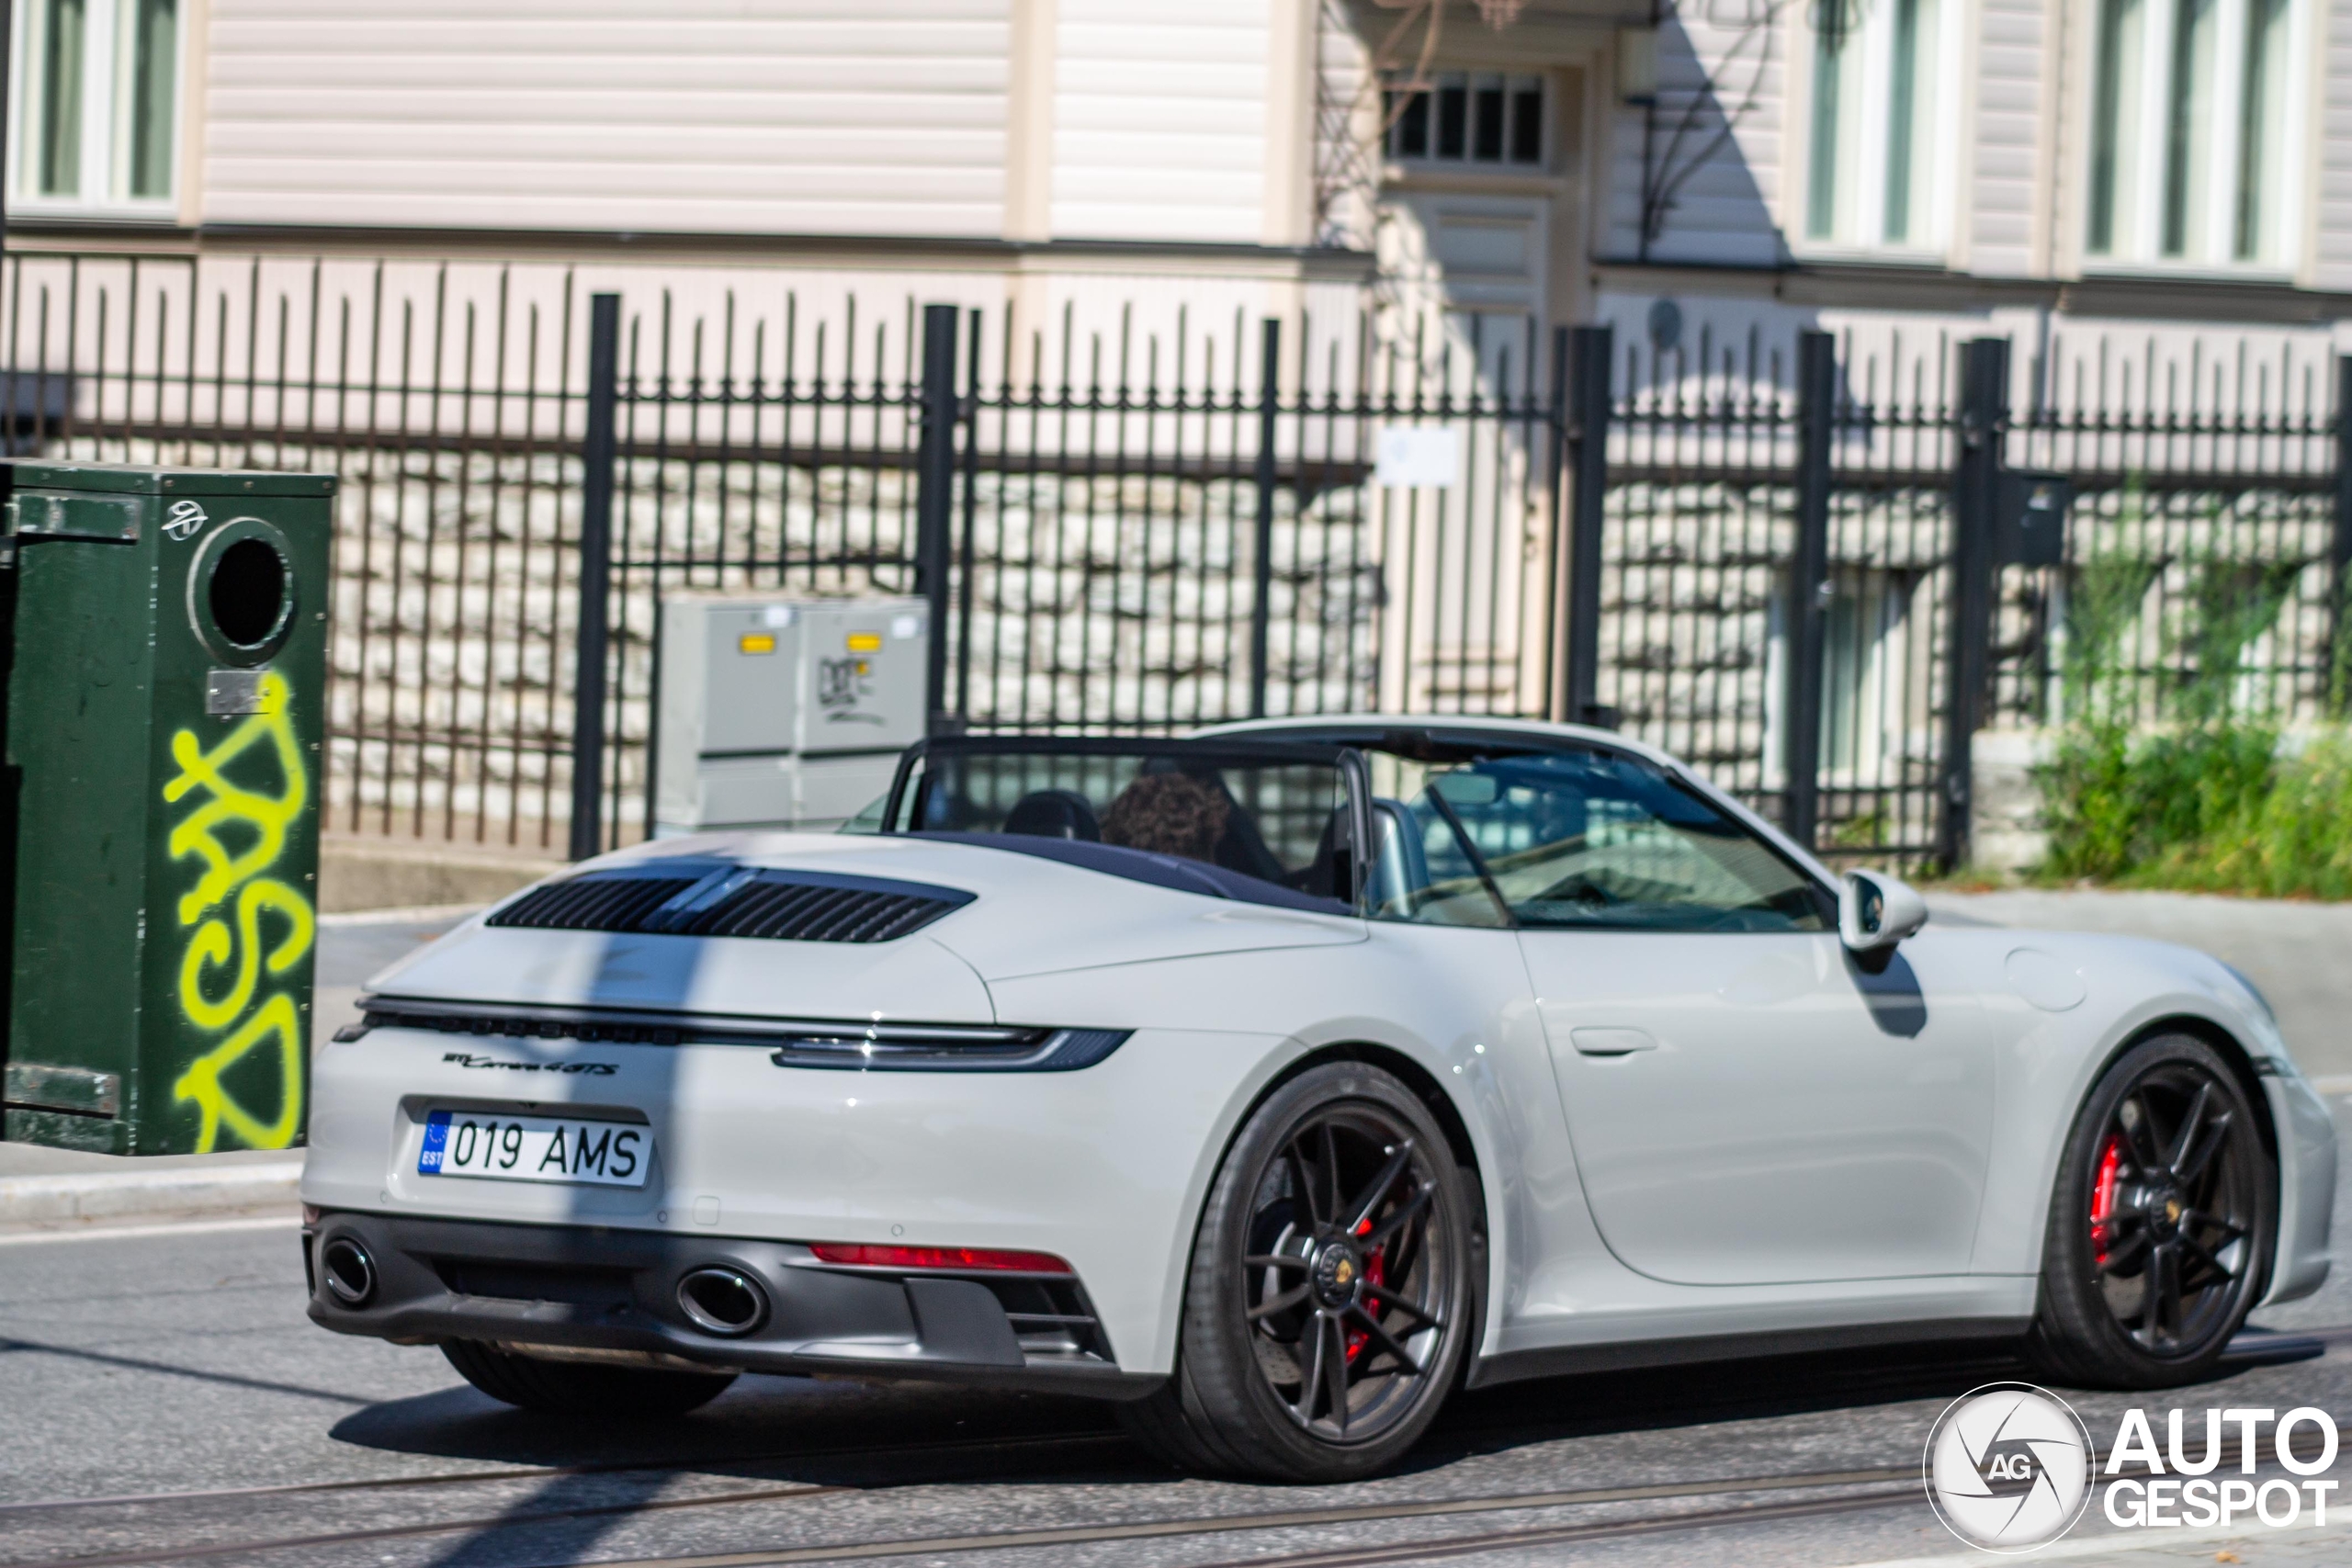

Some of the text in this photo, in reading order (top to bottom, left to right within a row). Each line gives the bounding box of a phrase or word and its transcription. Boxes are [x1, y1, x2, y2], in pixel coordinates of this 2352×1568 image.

[422, 1151, 444, 1166] EST
[454, 1120, 641, 1178] 019 AMS
